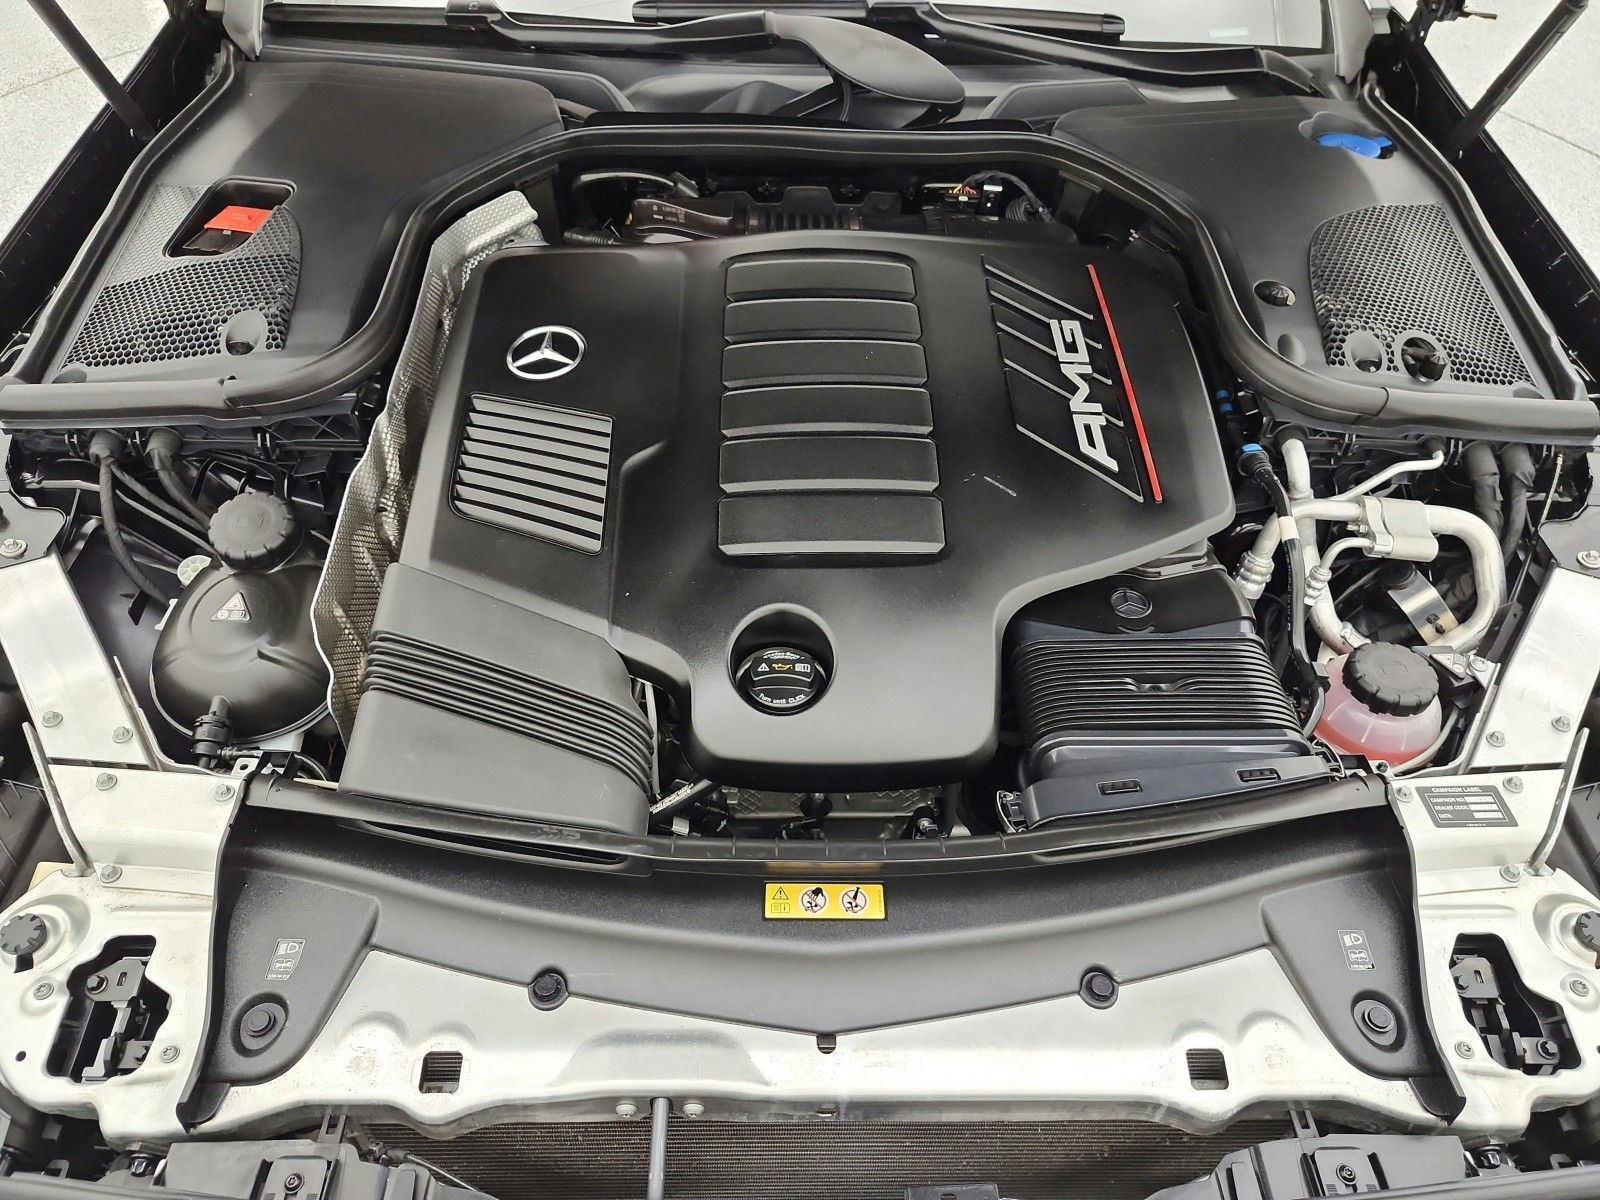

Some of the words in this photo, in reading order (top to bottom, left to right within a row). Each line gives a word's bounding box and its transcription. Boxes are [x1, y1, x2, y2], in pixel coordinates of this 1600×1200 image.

[1049, 319, 1119, 473] AMG
[759, 693, 772, 703] Turn
[788, 693, 806, 704] CLICK
